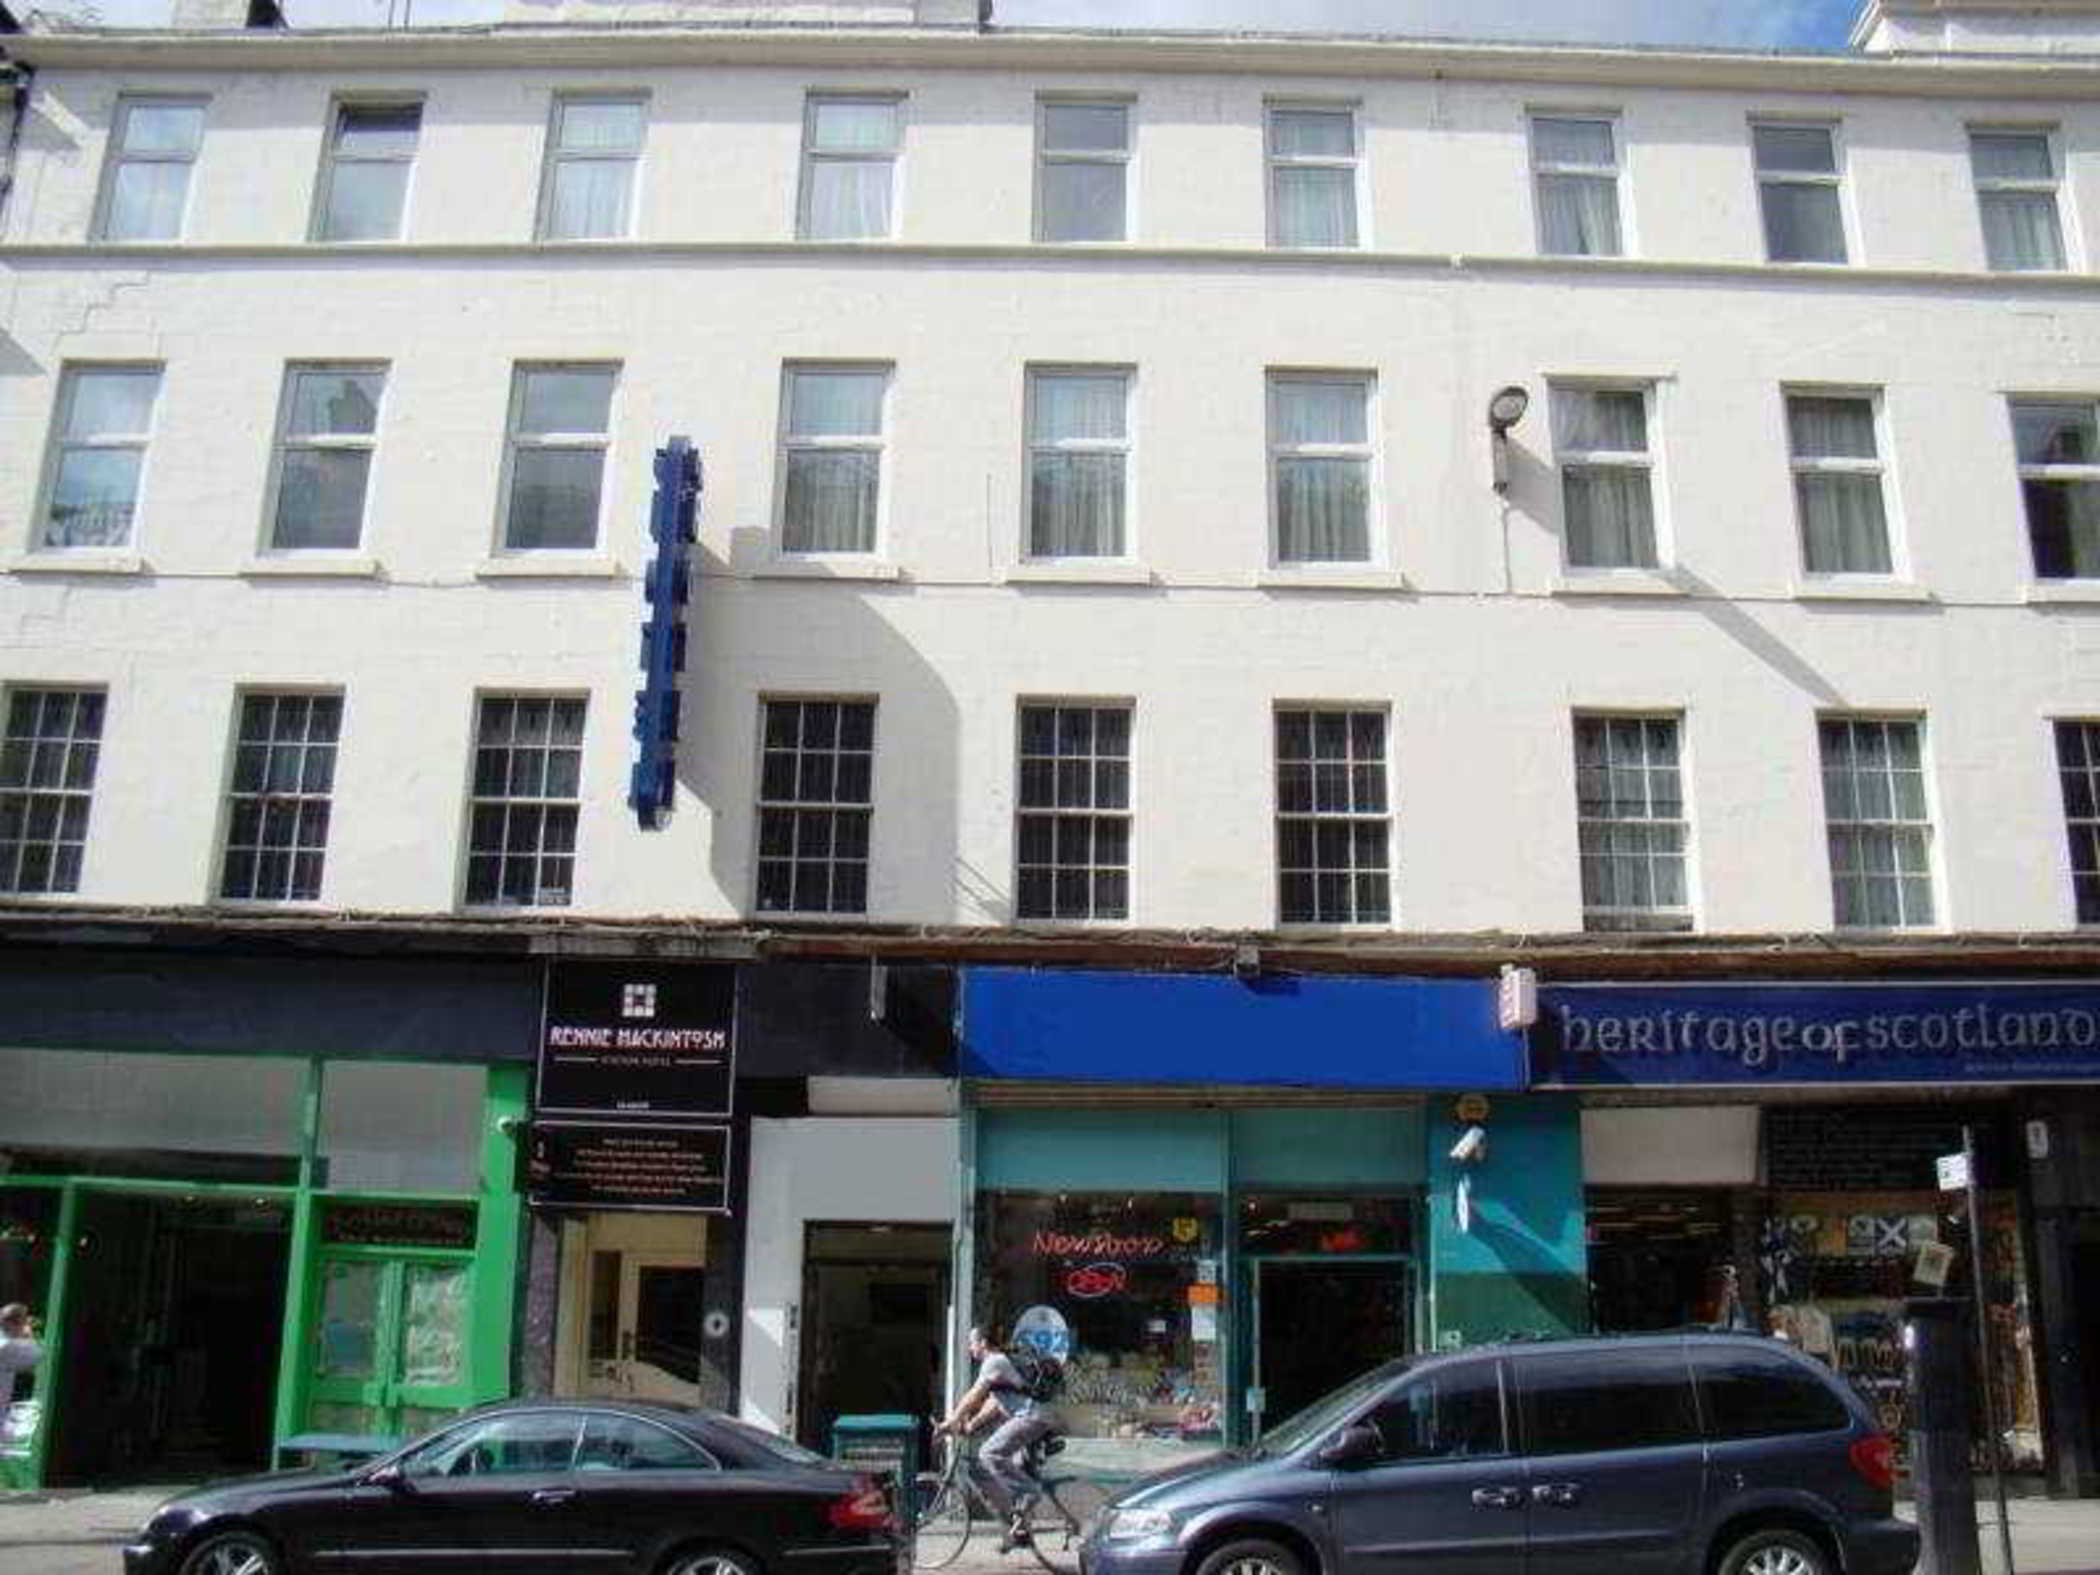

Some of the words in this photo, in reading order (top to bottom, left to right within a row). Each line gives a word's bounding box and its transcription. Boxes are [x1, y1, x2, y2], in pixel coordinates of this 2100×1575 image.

[550, 1026, 611, 1046] RENNIE
[617, 1029, 726, 1050] MACKINTOSH
[1560, 1004, 1796, 1066] heritage
[1802, 1021, 1859, 1064] of
[1866, 1003, 2097, 1049] scotland
